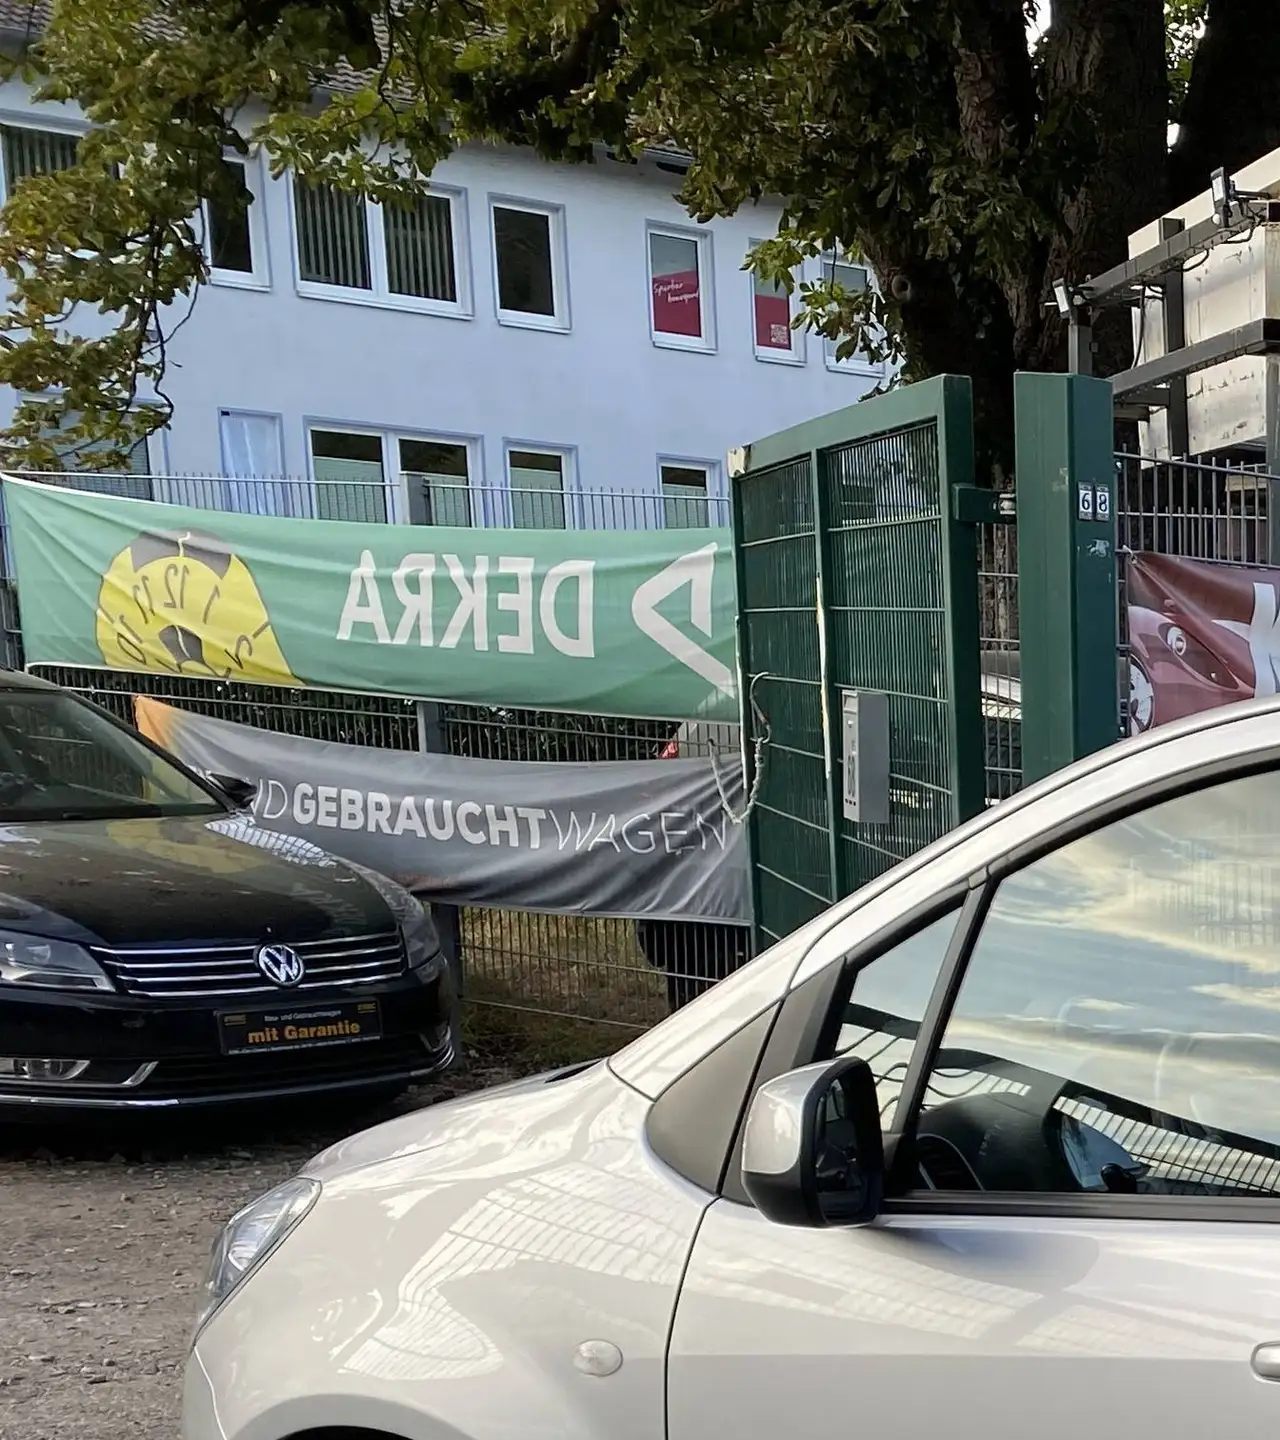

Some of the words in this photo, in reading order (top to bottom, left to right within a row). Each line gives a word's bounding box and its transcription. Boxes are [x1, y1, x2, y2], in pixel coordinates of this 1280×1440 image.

[1081, 492, 1109, 512] 68
[247, 1027, 280, 1044] mit
[284, 1020, 361, 1040] Garantie
